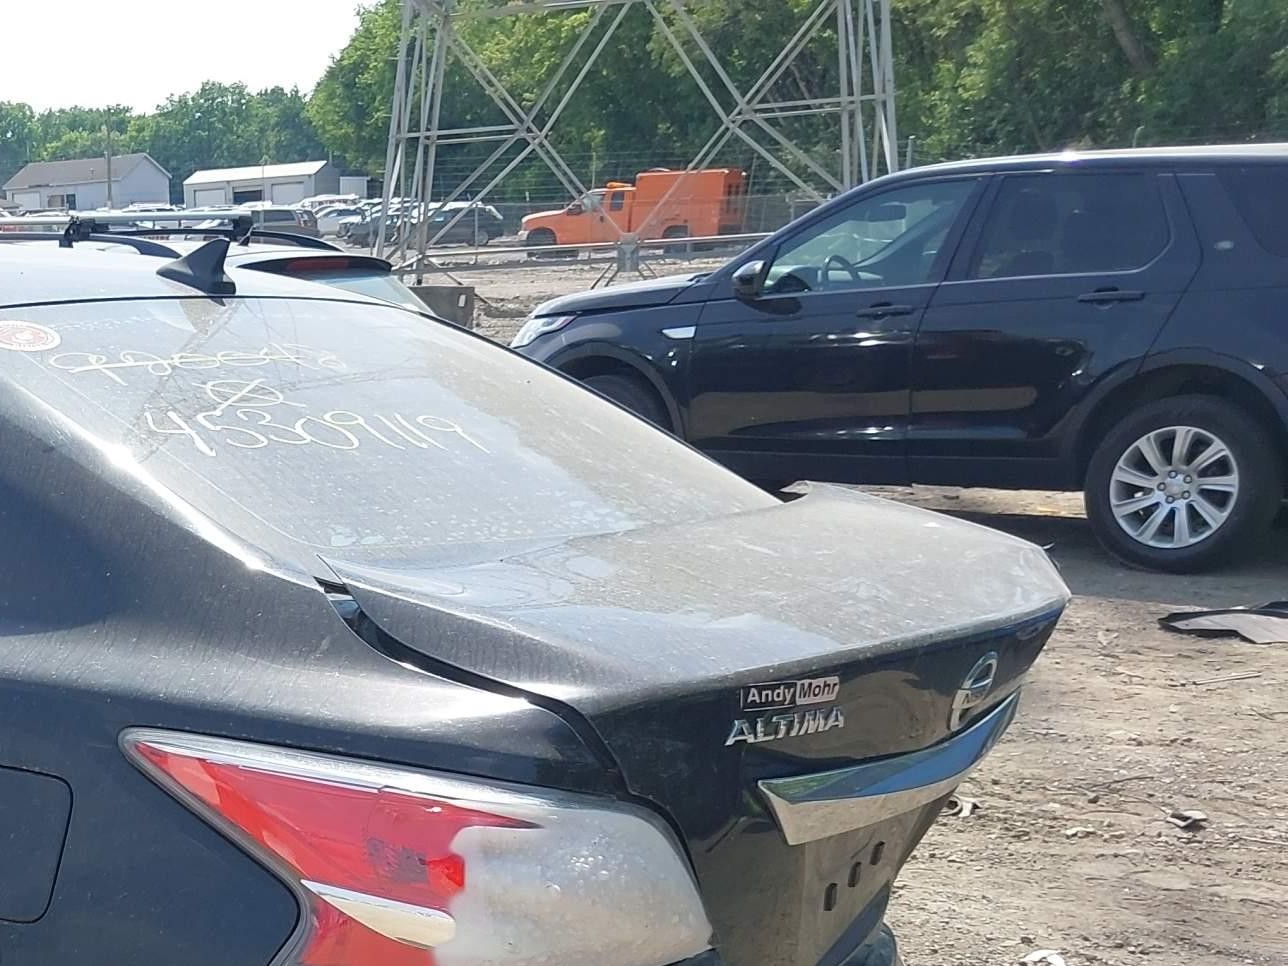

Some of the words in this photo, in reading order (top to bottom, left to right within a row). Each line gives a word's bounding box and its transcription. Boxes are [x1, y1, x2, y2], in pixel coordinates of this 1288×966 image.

[144, 407, 491, 457] 45309119
[746, 685, 795, 705] Andy
[797, 681, 838, 700] Mohr
[724, 706, 845, 746] ALTIMA
